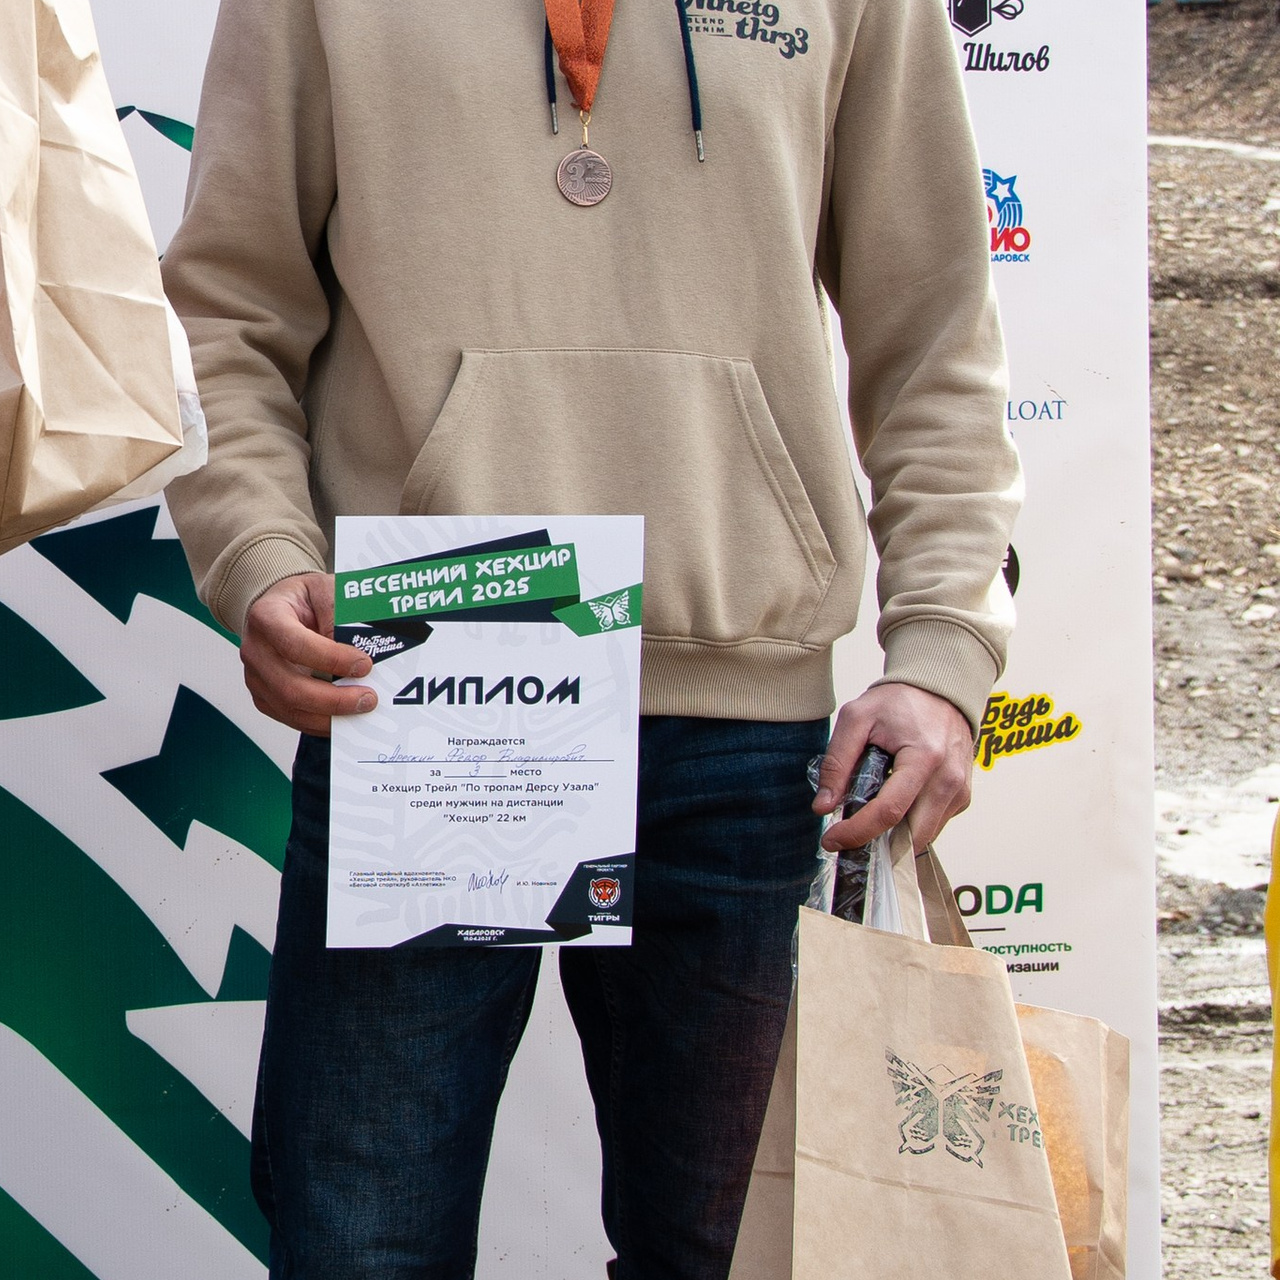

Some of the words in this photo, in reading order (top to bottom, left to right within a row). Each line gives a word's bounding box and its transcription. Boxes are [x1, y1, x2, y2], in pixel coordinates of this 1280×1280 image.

[566, 163, 586, 193] 3
[991, 253, 1030, 263] АРОВСК
[344, 563, 467, 599] ВЕСЕННИЙ
[475, 548, 571, 578] ХЕХЦИР
[389, 587, 464, 614] ТРЕЙЛ
[471, 576, 530, 602] 2025
[392, 675, 581, 705] ДИПЛОМ
[447, 737, 525, 747] Награждается
[469, 764, 479, 777] 3
[510, 769, 542, 777] место
[381, 784, 421, 795] Хехцир
[425, 783, 458, 792] Трейл
[461, 783, 481, 792] "По
[484, 784, 523, 794] тропам
[525, 783, 559, 794] Дерсу
[562, 783, 599, 792] Узала"
[410, 799, 443, 809] среди
[446, 799, 488, 809] мужчин
[491, 799, 503, 807] на
[506, 798, 564, 808] дистанции
[443, 814, 494, 824] "Хехцир"
[497, 814, 509, 822] 22
[513, 814, 526, 822] км
[1007, 1124, 1044, 1148] ТРЕ
